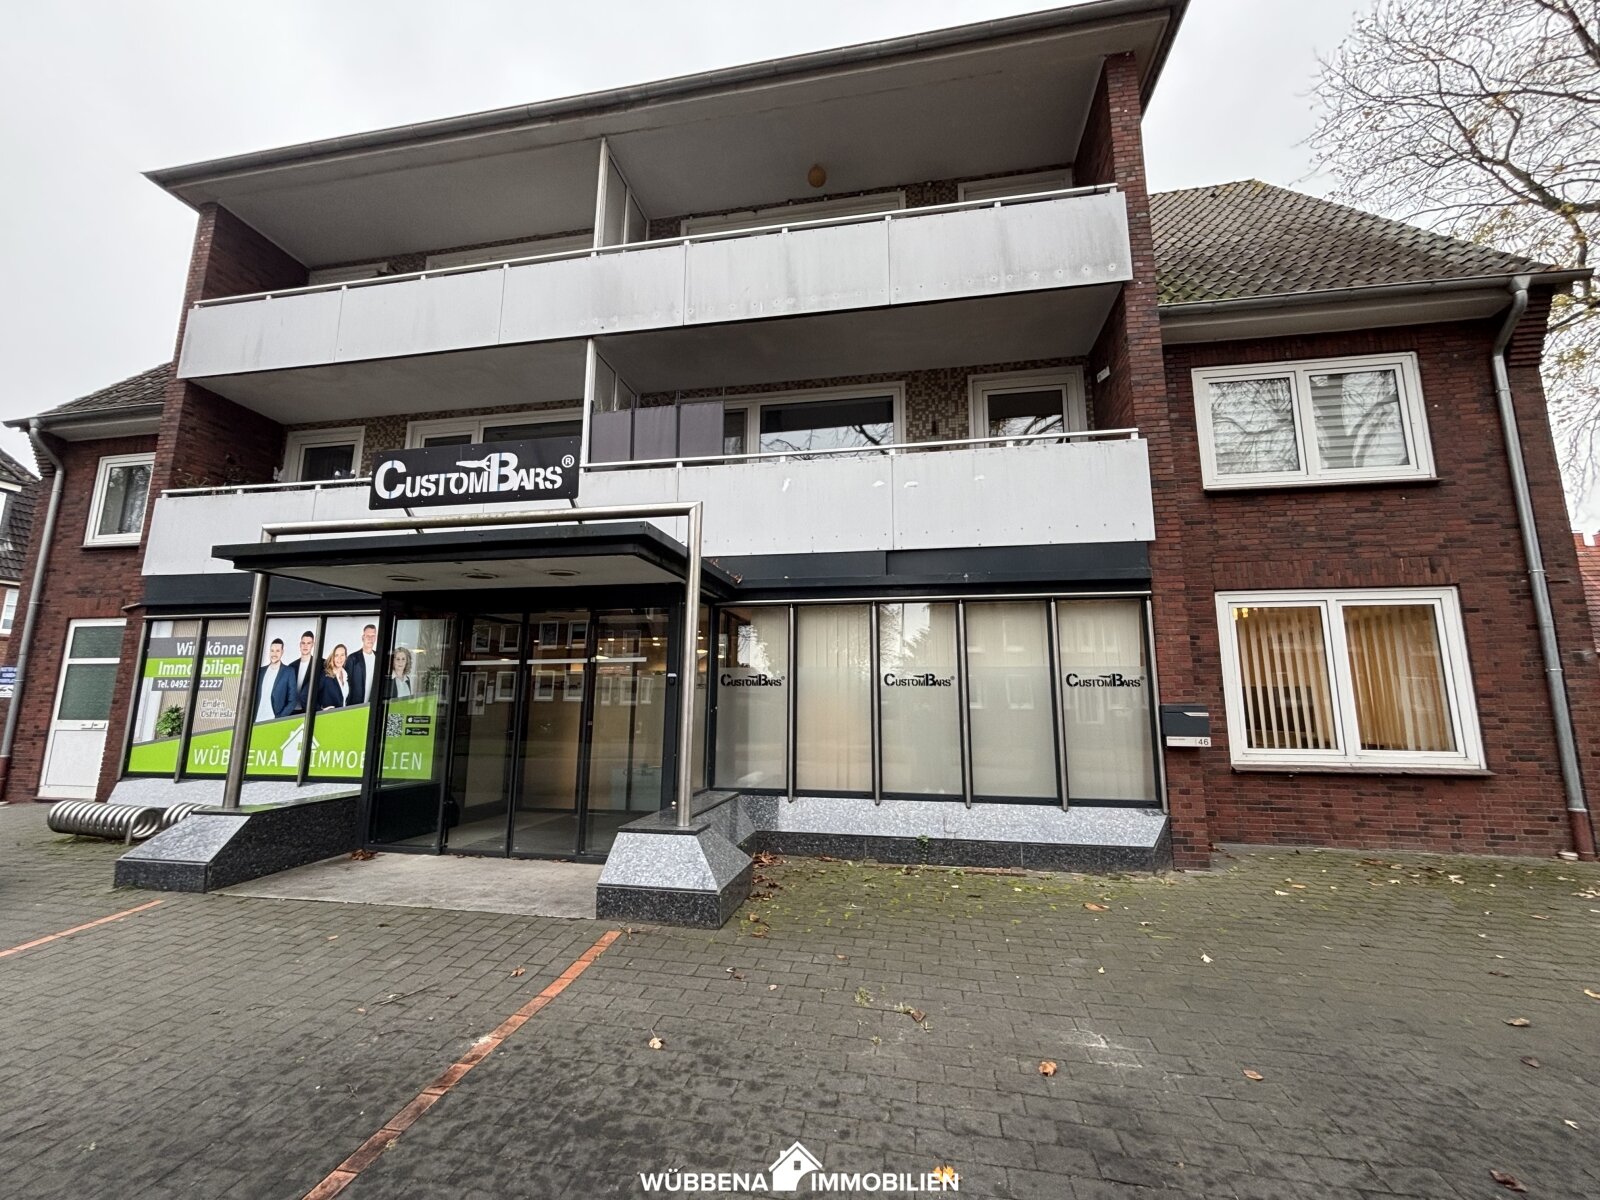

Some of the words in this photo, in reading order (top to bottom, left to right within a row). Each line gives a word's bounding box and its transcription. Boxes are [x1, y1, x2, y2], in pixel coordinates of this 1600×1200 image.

[206, 641, 244, 655] könne
[157, 680, 169, 688] Tel.
[170, 680, 191, 688] 0492
[1198, 738, 1209, 746] 46
[194, 745, 278, 767] WÜBENA
